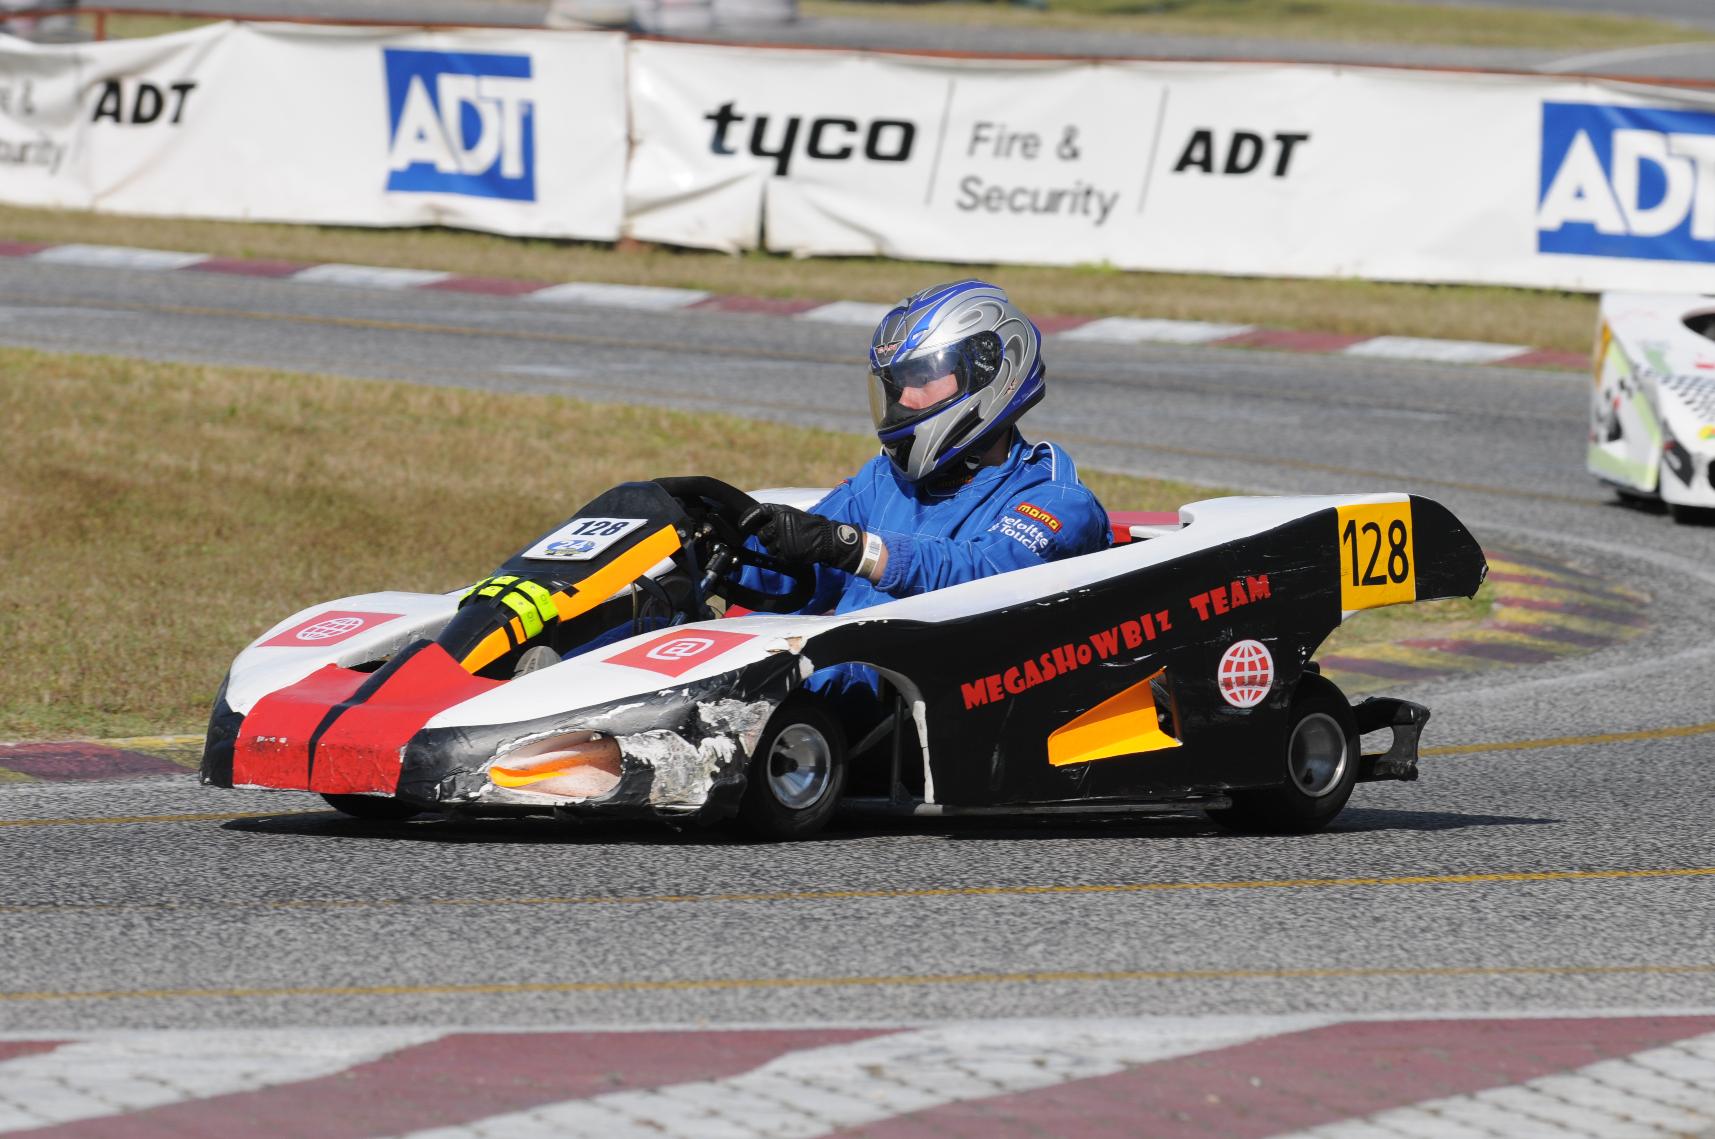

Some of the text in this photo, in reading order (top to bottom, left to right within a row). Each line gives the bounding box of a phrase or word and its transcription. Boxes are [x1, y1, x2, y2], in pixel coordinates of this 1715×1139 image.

[91, 78, 197, 125] ADT
[386, 72, 535, 178] ADT
[703, 100, 917, 176] tyco
[966, 120, 1081, 161] Fire &
[1172, 128, 1309, 178] ADT
[955, 174, 1120, 227] Security
[1537, 128, 1715, 241] ADT
[571, 520, 630, 536] 128
[1342, 518, 1410, 588] 128
[1189, 573, 1272, 622] TEAM
